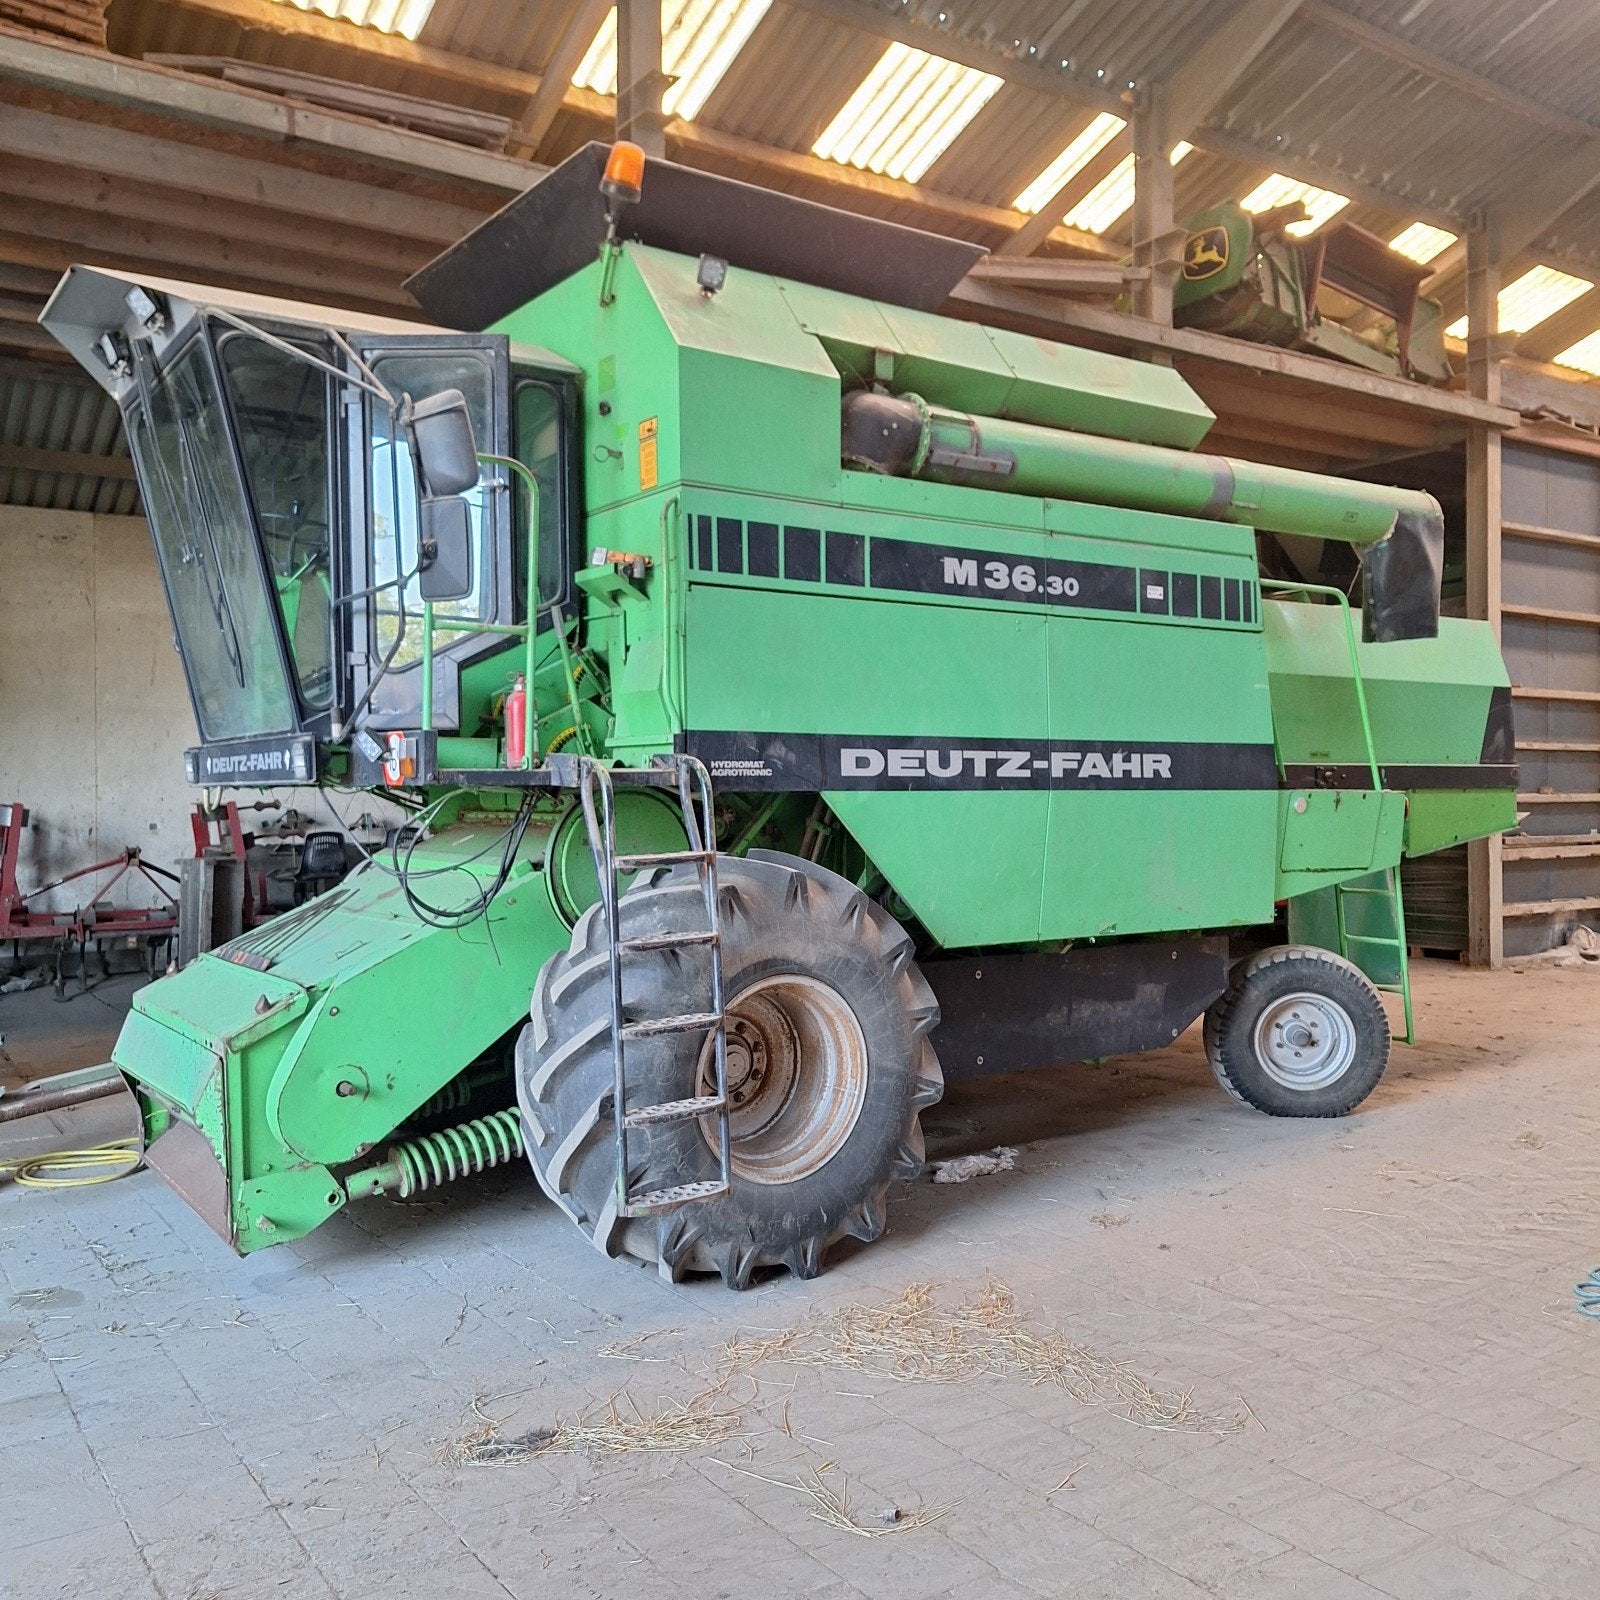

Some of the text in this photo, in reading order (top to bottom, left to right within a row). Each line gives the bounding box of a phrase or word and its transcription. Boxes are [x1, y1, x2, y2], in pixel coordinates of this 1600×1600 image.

[943, 556, 1080, 597] M 36.30
[211, 750, 283, 774] DEUTZ-FAHR
[710, 760, 765, 768] HYDROMAT
[710, 768, 773, 777] AGROTRONIC
[840, 748, 1172, 779] DEUTZ-FAHR
